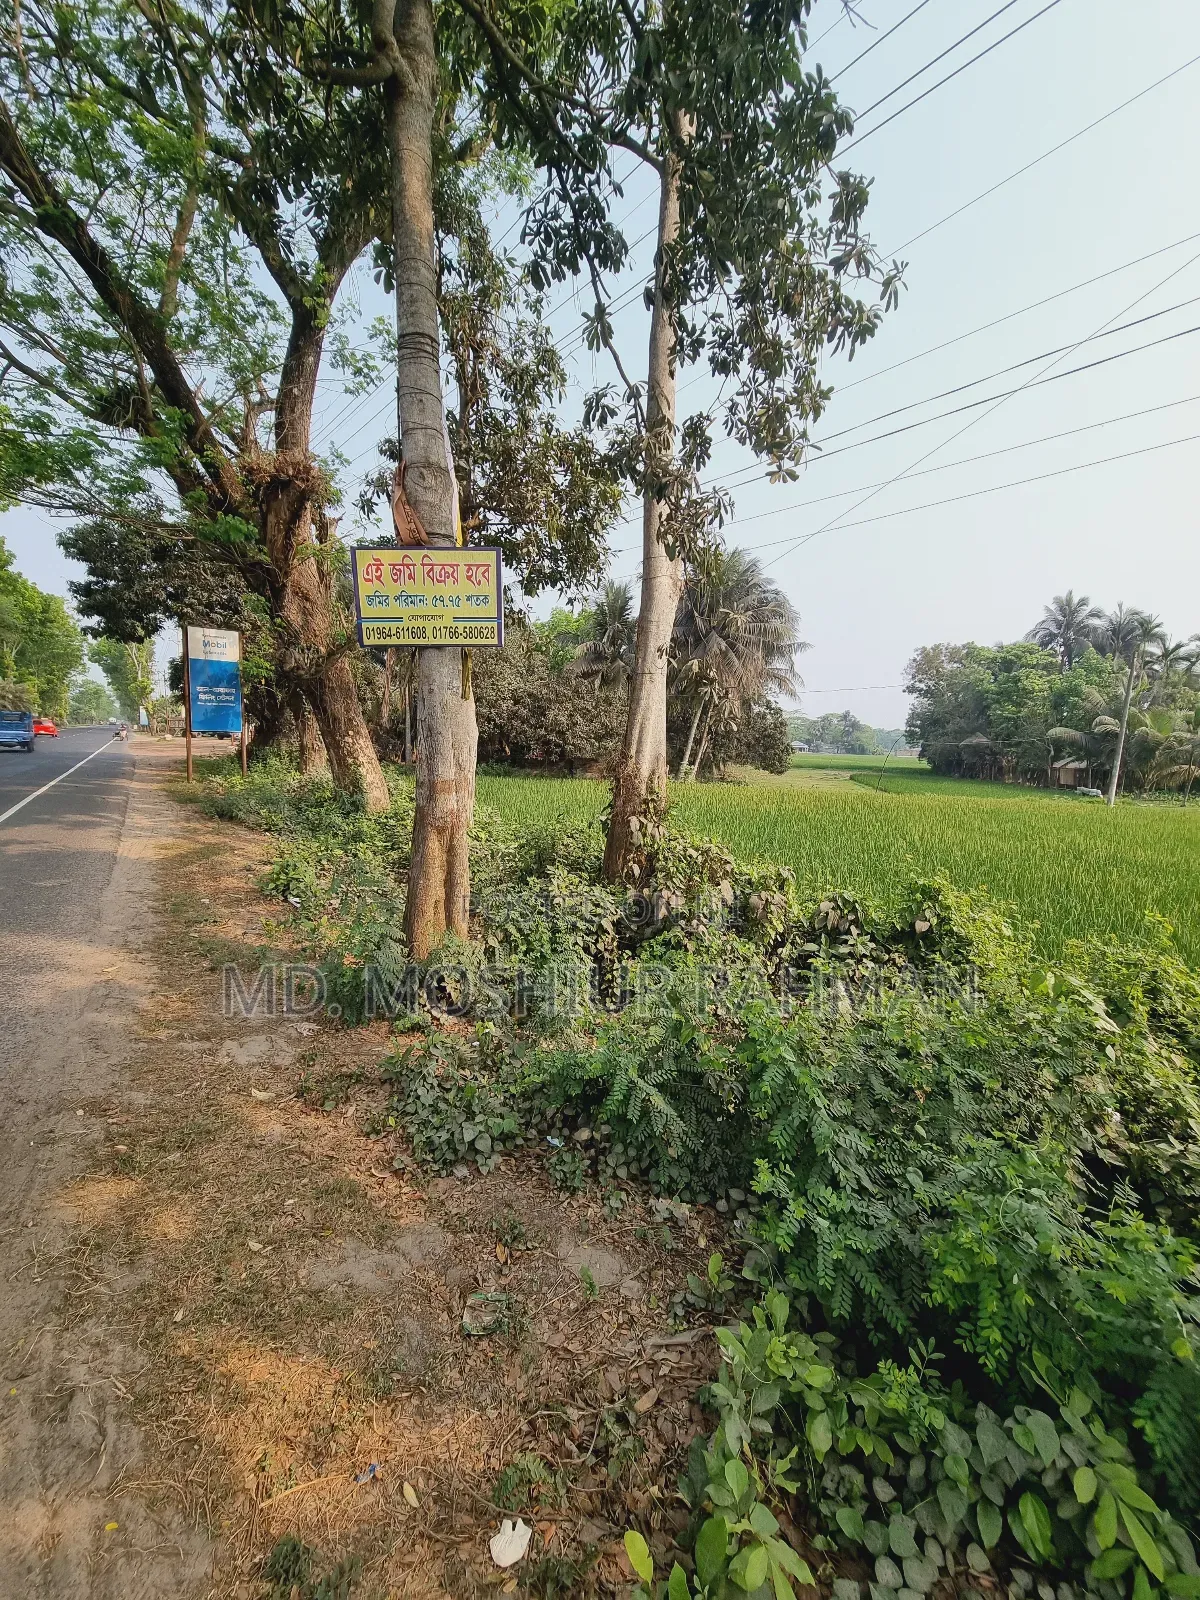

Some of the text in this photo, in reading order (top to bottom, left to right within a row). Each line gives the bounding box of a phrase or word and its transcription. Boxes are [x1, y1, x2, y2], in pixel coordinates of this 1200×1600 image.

[362, 554, 492, 587] এই জমি বিক্রয় হবে
[365, 590, 490, 608] জমির পরিমান: ৫৭.৭৫ শতক
[407, 613, 445, 622] যোগাযোগ
[365, 626, 496, 642] 01964-611608, 01766-580628
[202, 640, 227, 649] Mobil
